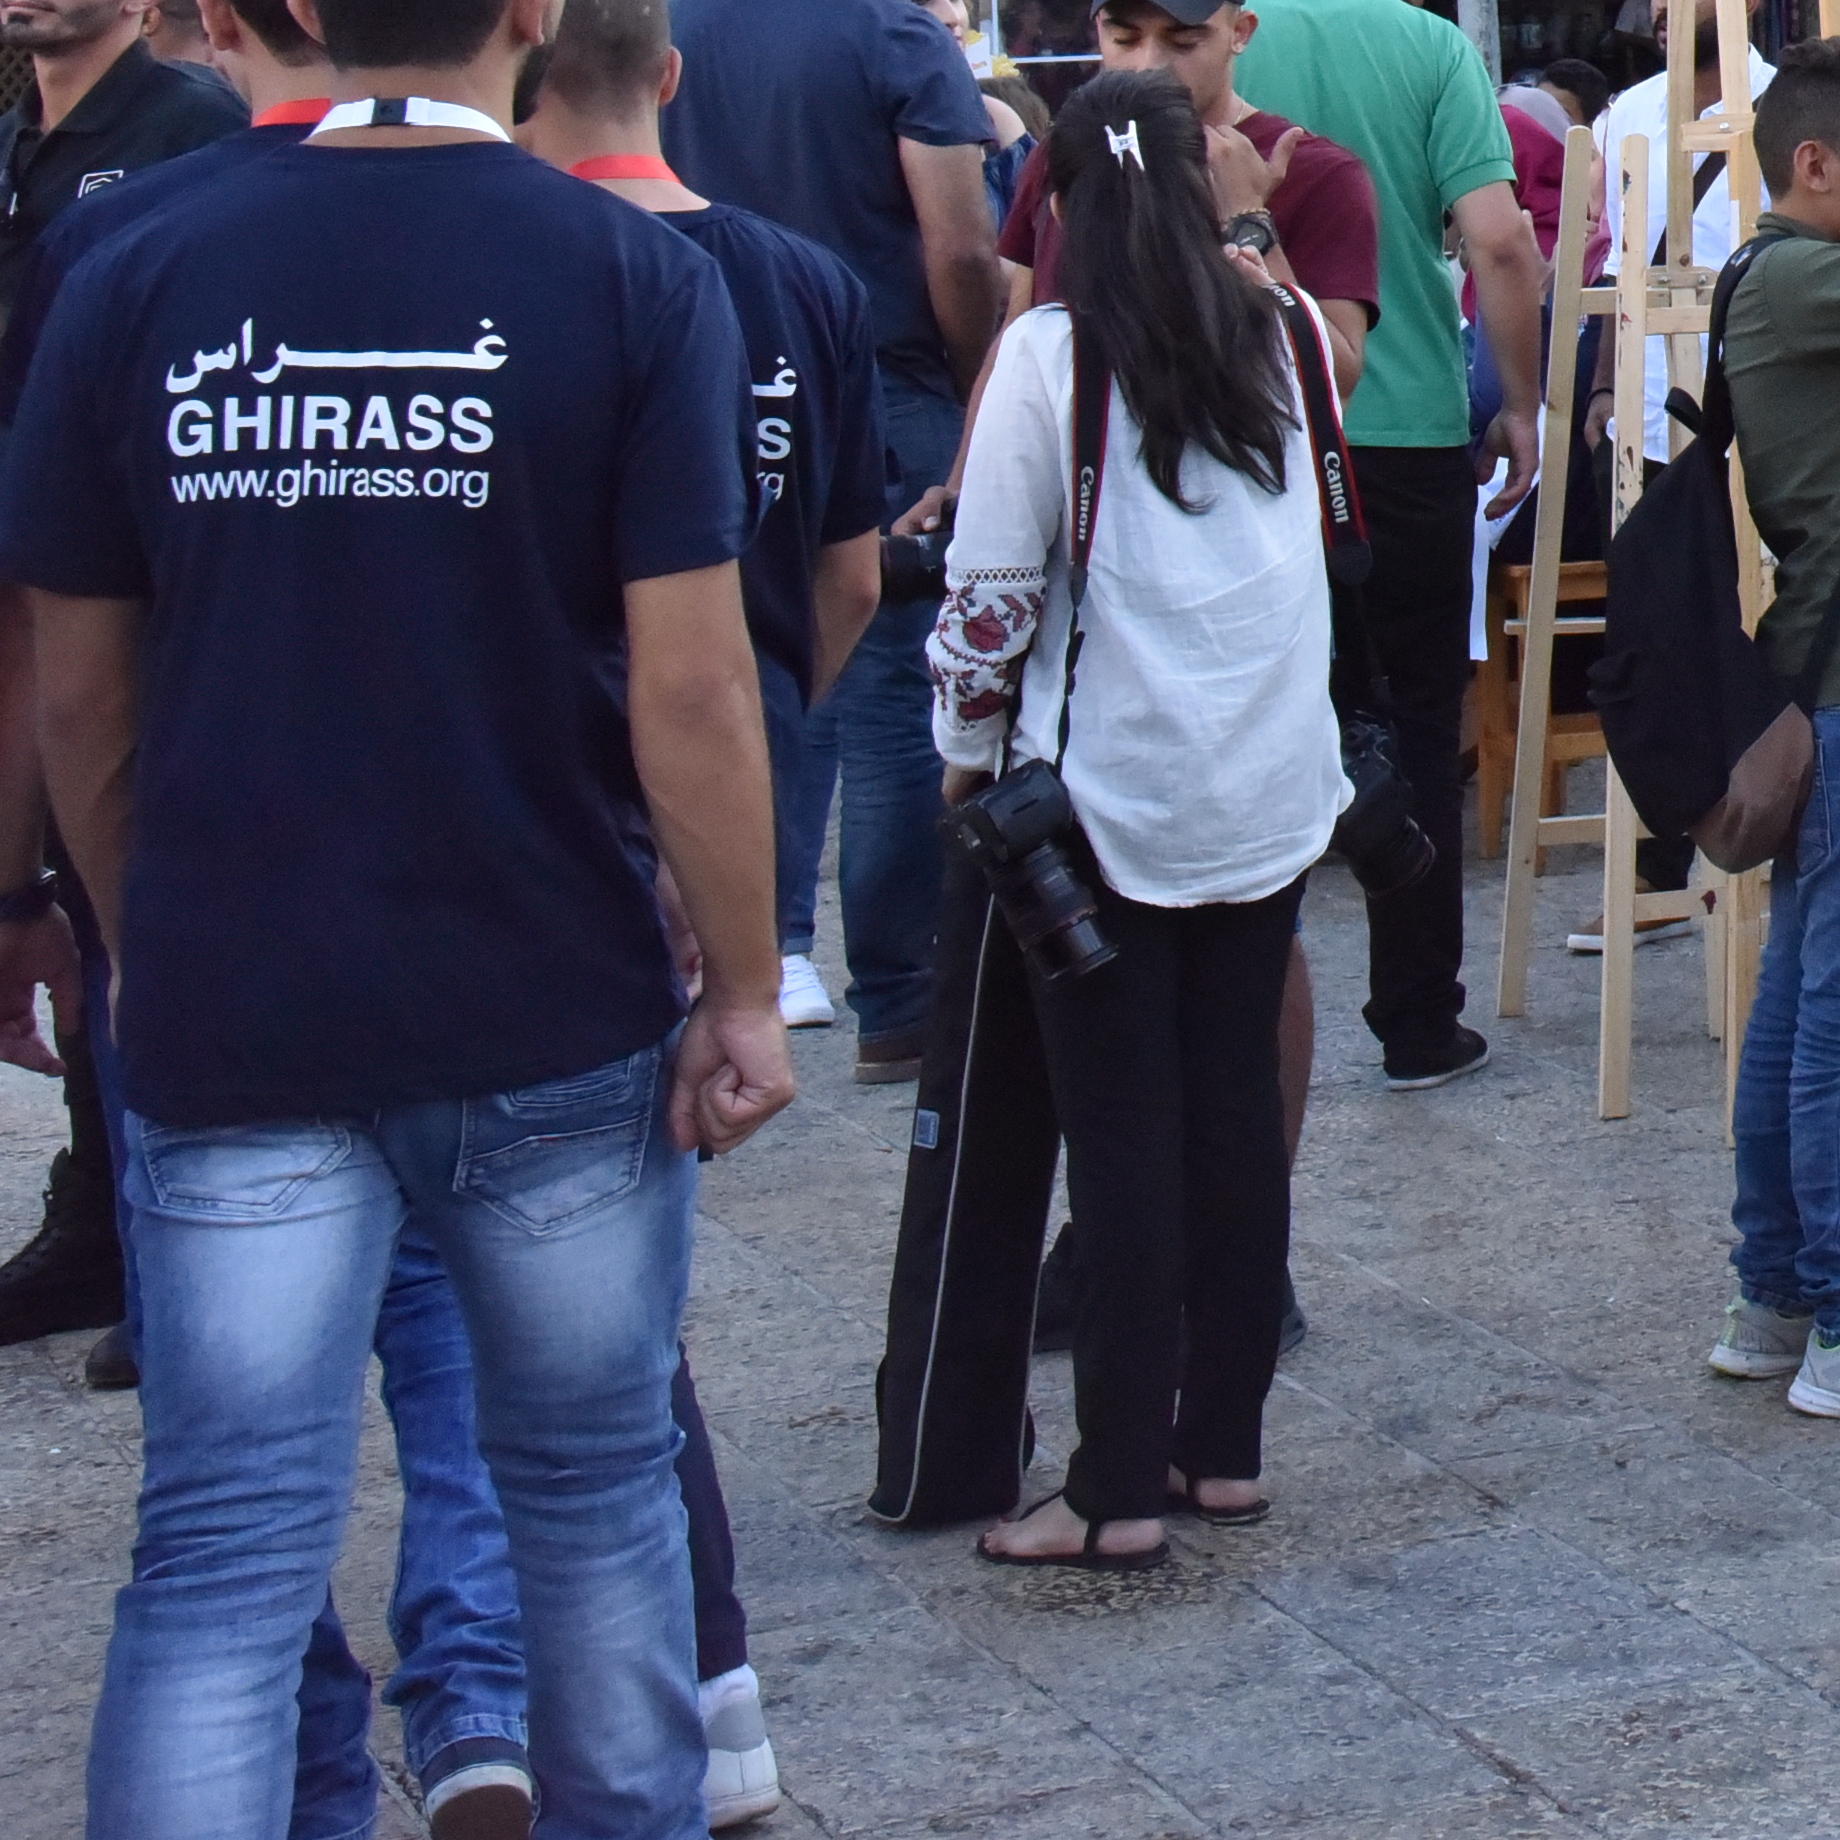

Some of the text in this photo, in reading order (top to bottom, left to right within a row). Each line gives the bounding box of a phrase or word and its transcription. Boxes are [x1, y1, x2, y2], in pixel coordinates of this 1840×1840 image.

[165, 317, 509, 393] غراس
[167, 393, 494, 457] GHIRASS
[171, 459, 490, 508] www.ghirass.org
[1078, 466, 1094, 540] Canon
[1324, 451, 1350, 523] Canon
